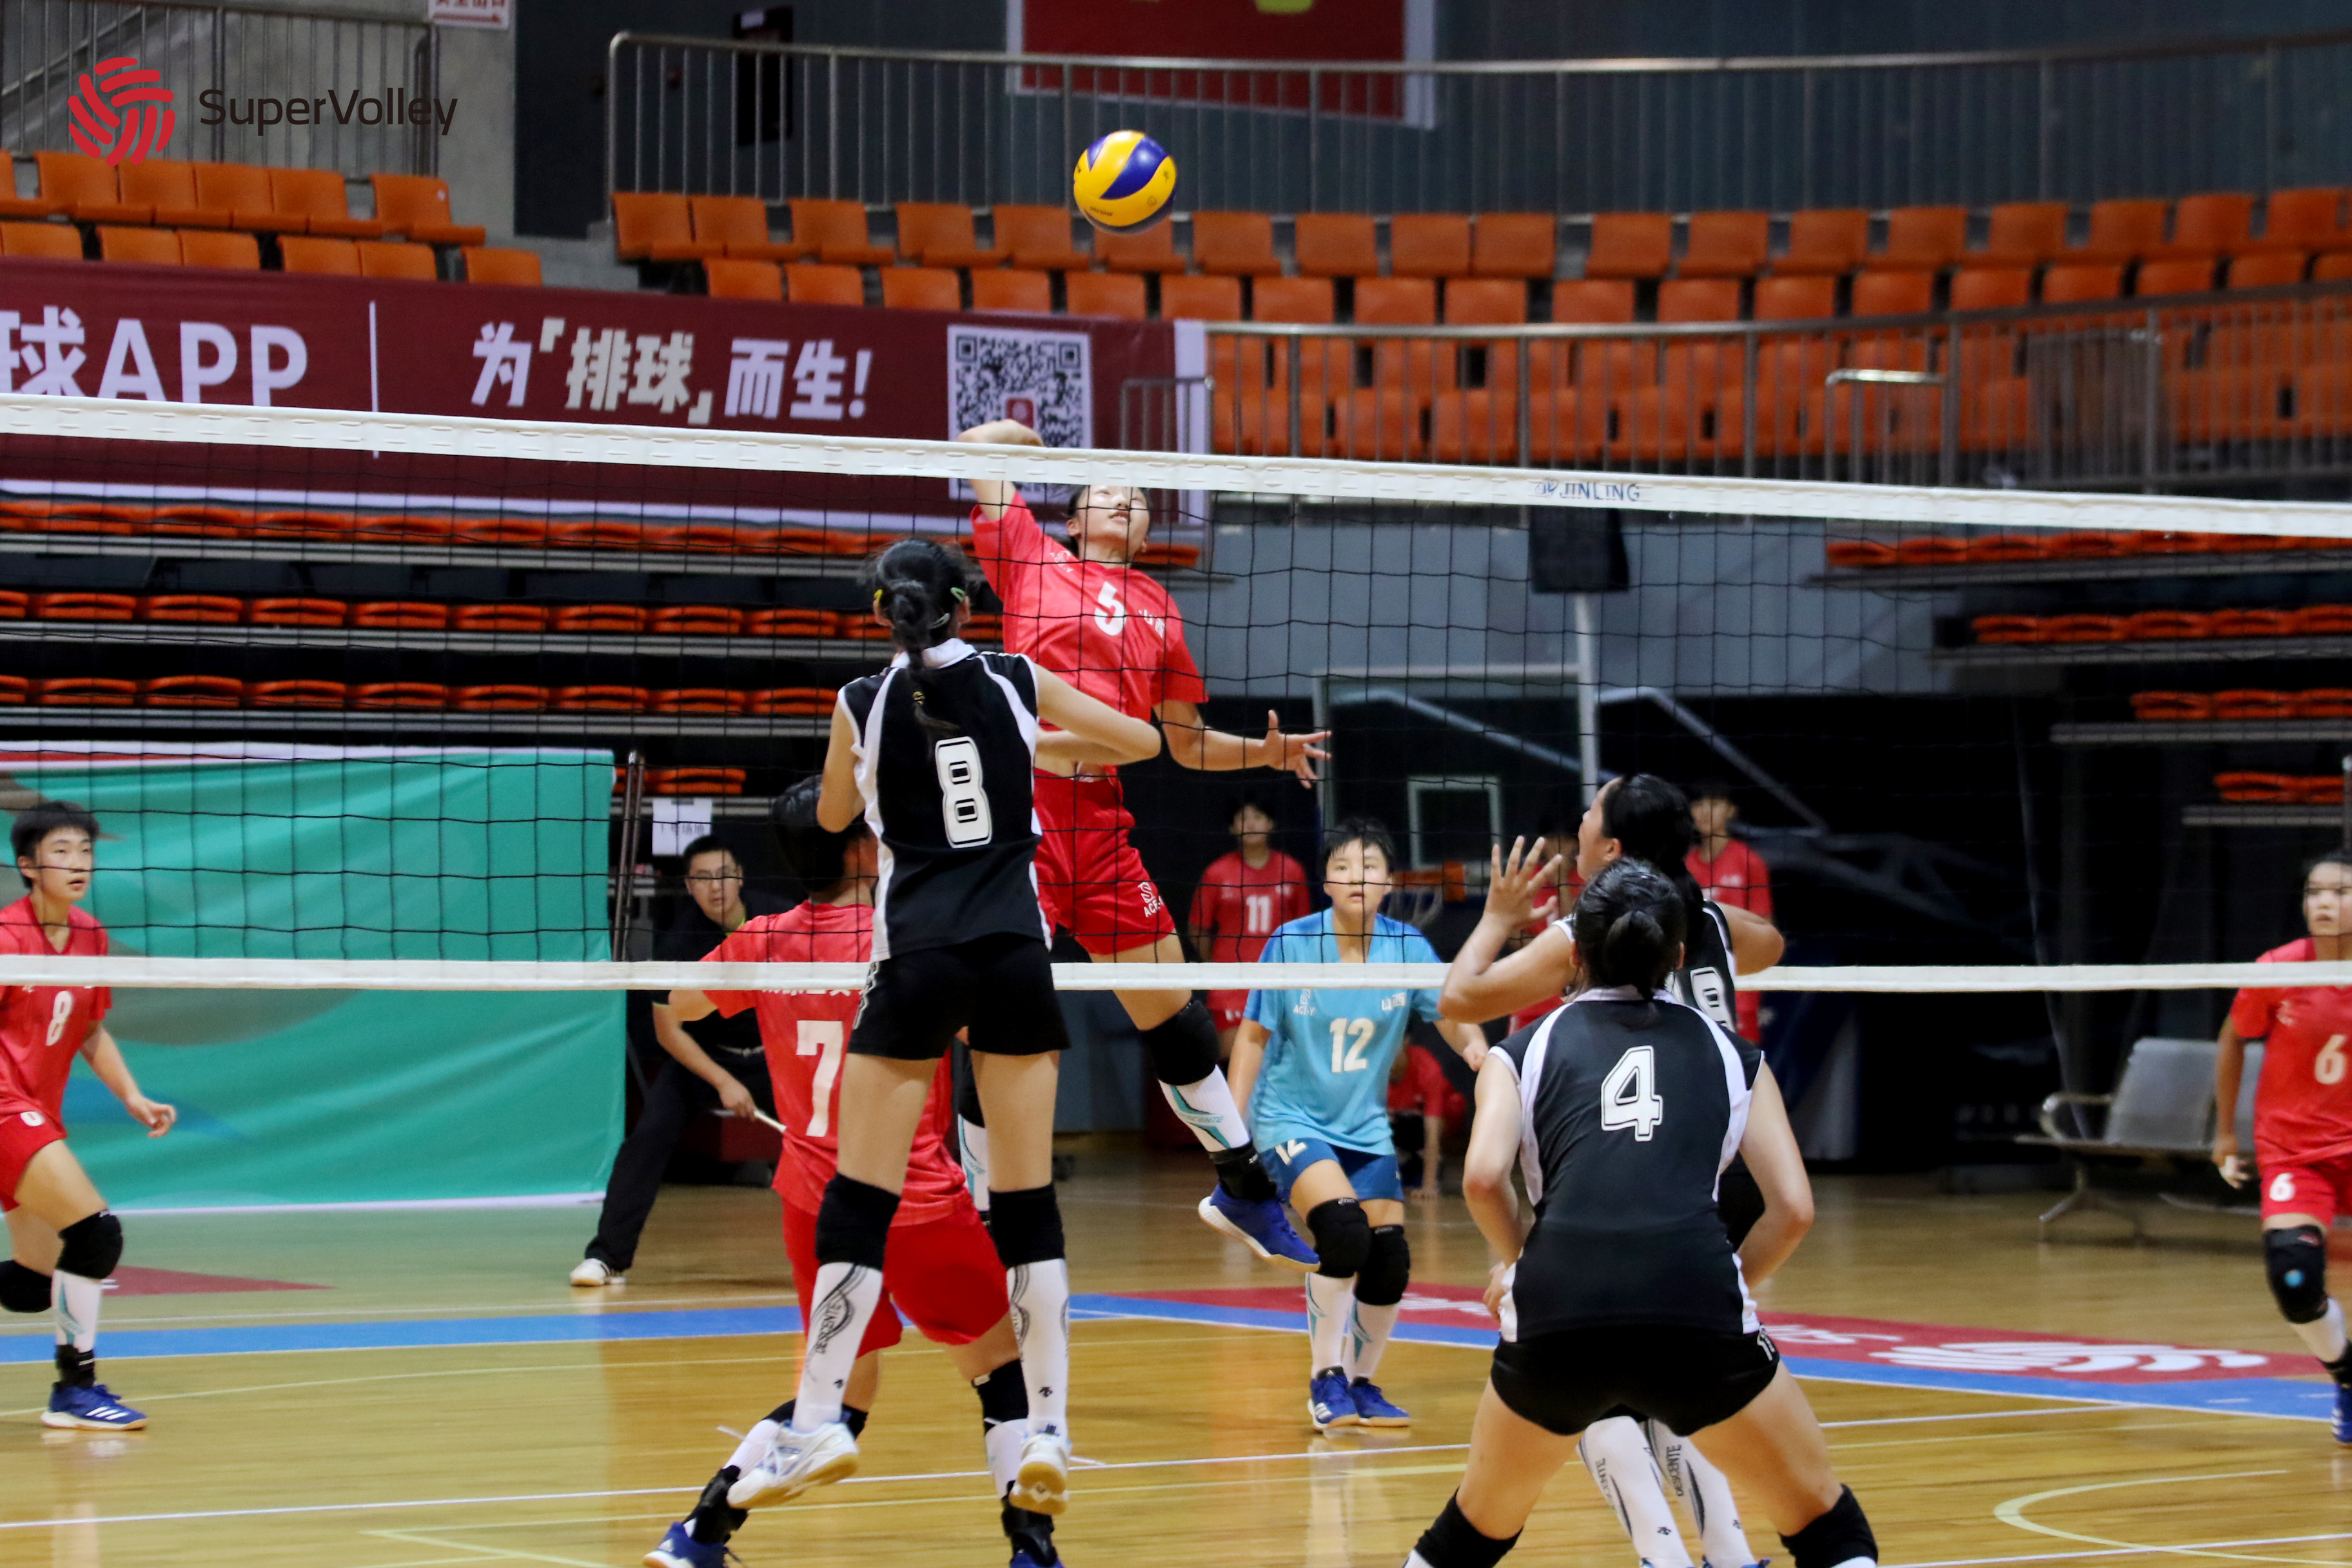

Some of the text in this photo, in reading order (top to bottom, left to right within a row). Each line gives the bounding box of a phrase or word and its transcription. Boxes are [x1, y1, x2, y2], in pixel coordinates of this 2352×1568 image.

[1560, 482, 1640, 502] JINLING
[1094, 581, 1126, 636] 5
[935, 736, 992, 849] 8
[1246, 895, 1270, 933] 11
[1329, 1017, 1375, 1073] 12
[2315, 1034, 2347, 1084] 6
[796, 1020, 844, 1137] 7
[1601, 1045, 1663, 1142] 4
[2269, 1172, 2295, 1202] 6
